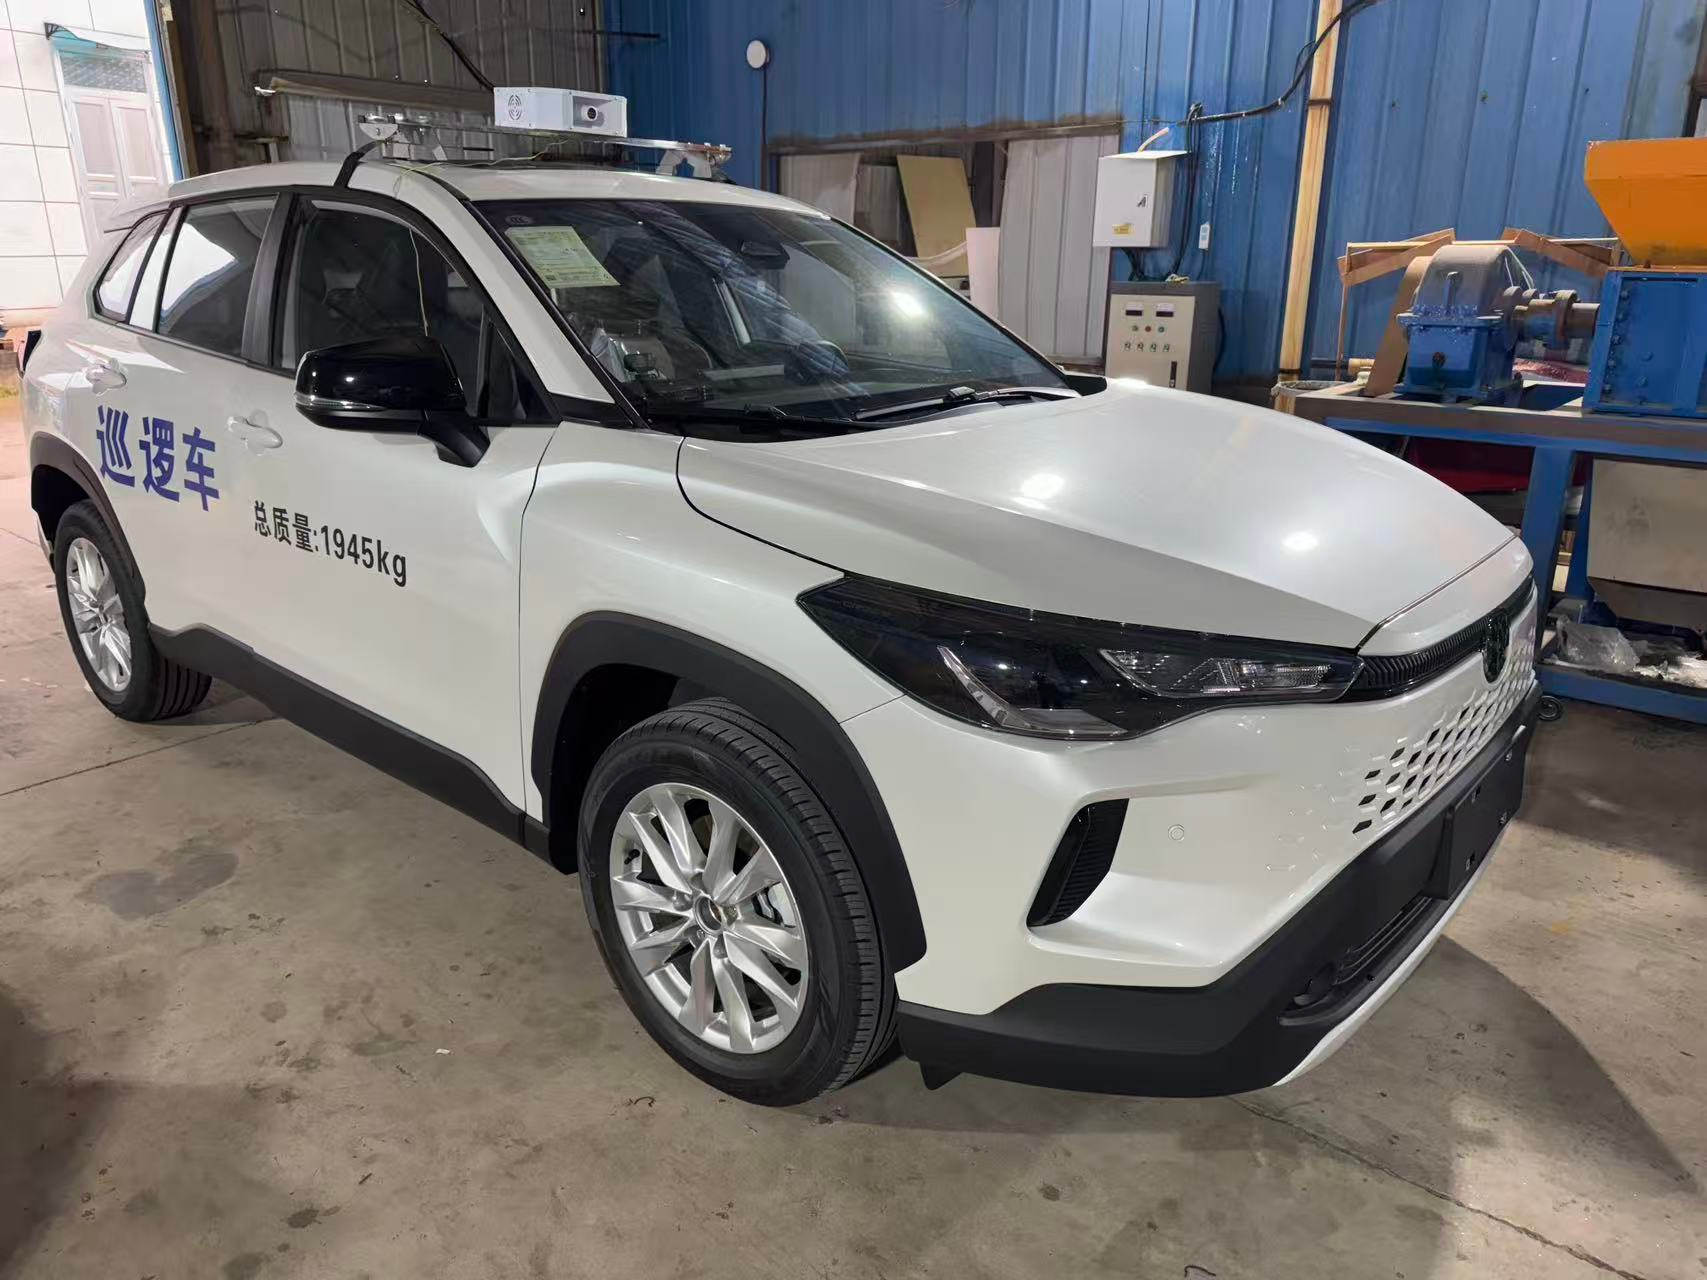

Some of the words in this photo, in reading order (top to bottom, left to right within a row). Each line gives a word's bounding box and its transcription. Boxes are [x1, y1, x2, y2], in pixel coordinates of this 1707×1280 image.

[97, 405, 219, 511] 巡逻车
[254, 501, 406, 587] 总质量:1945kg
